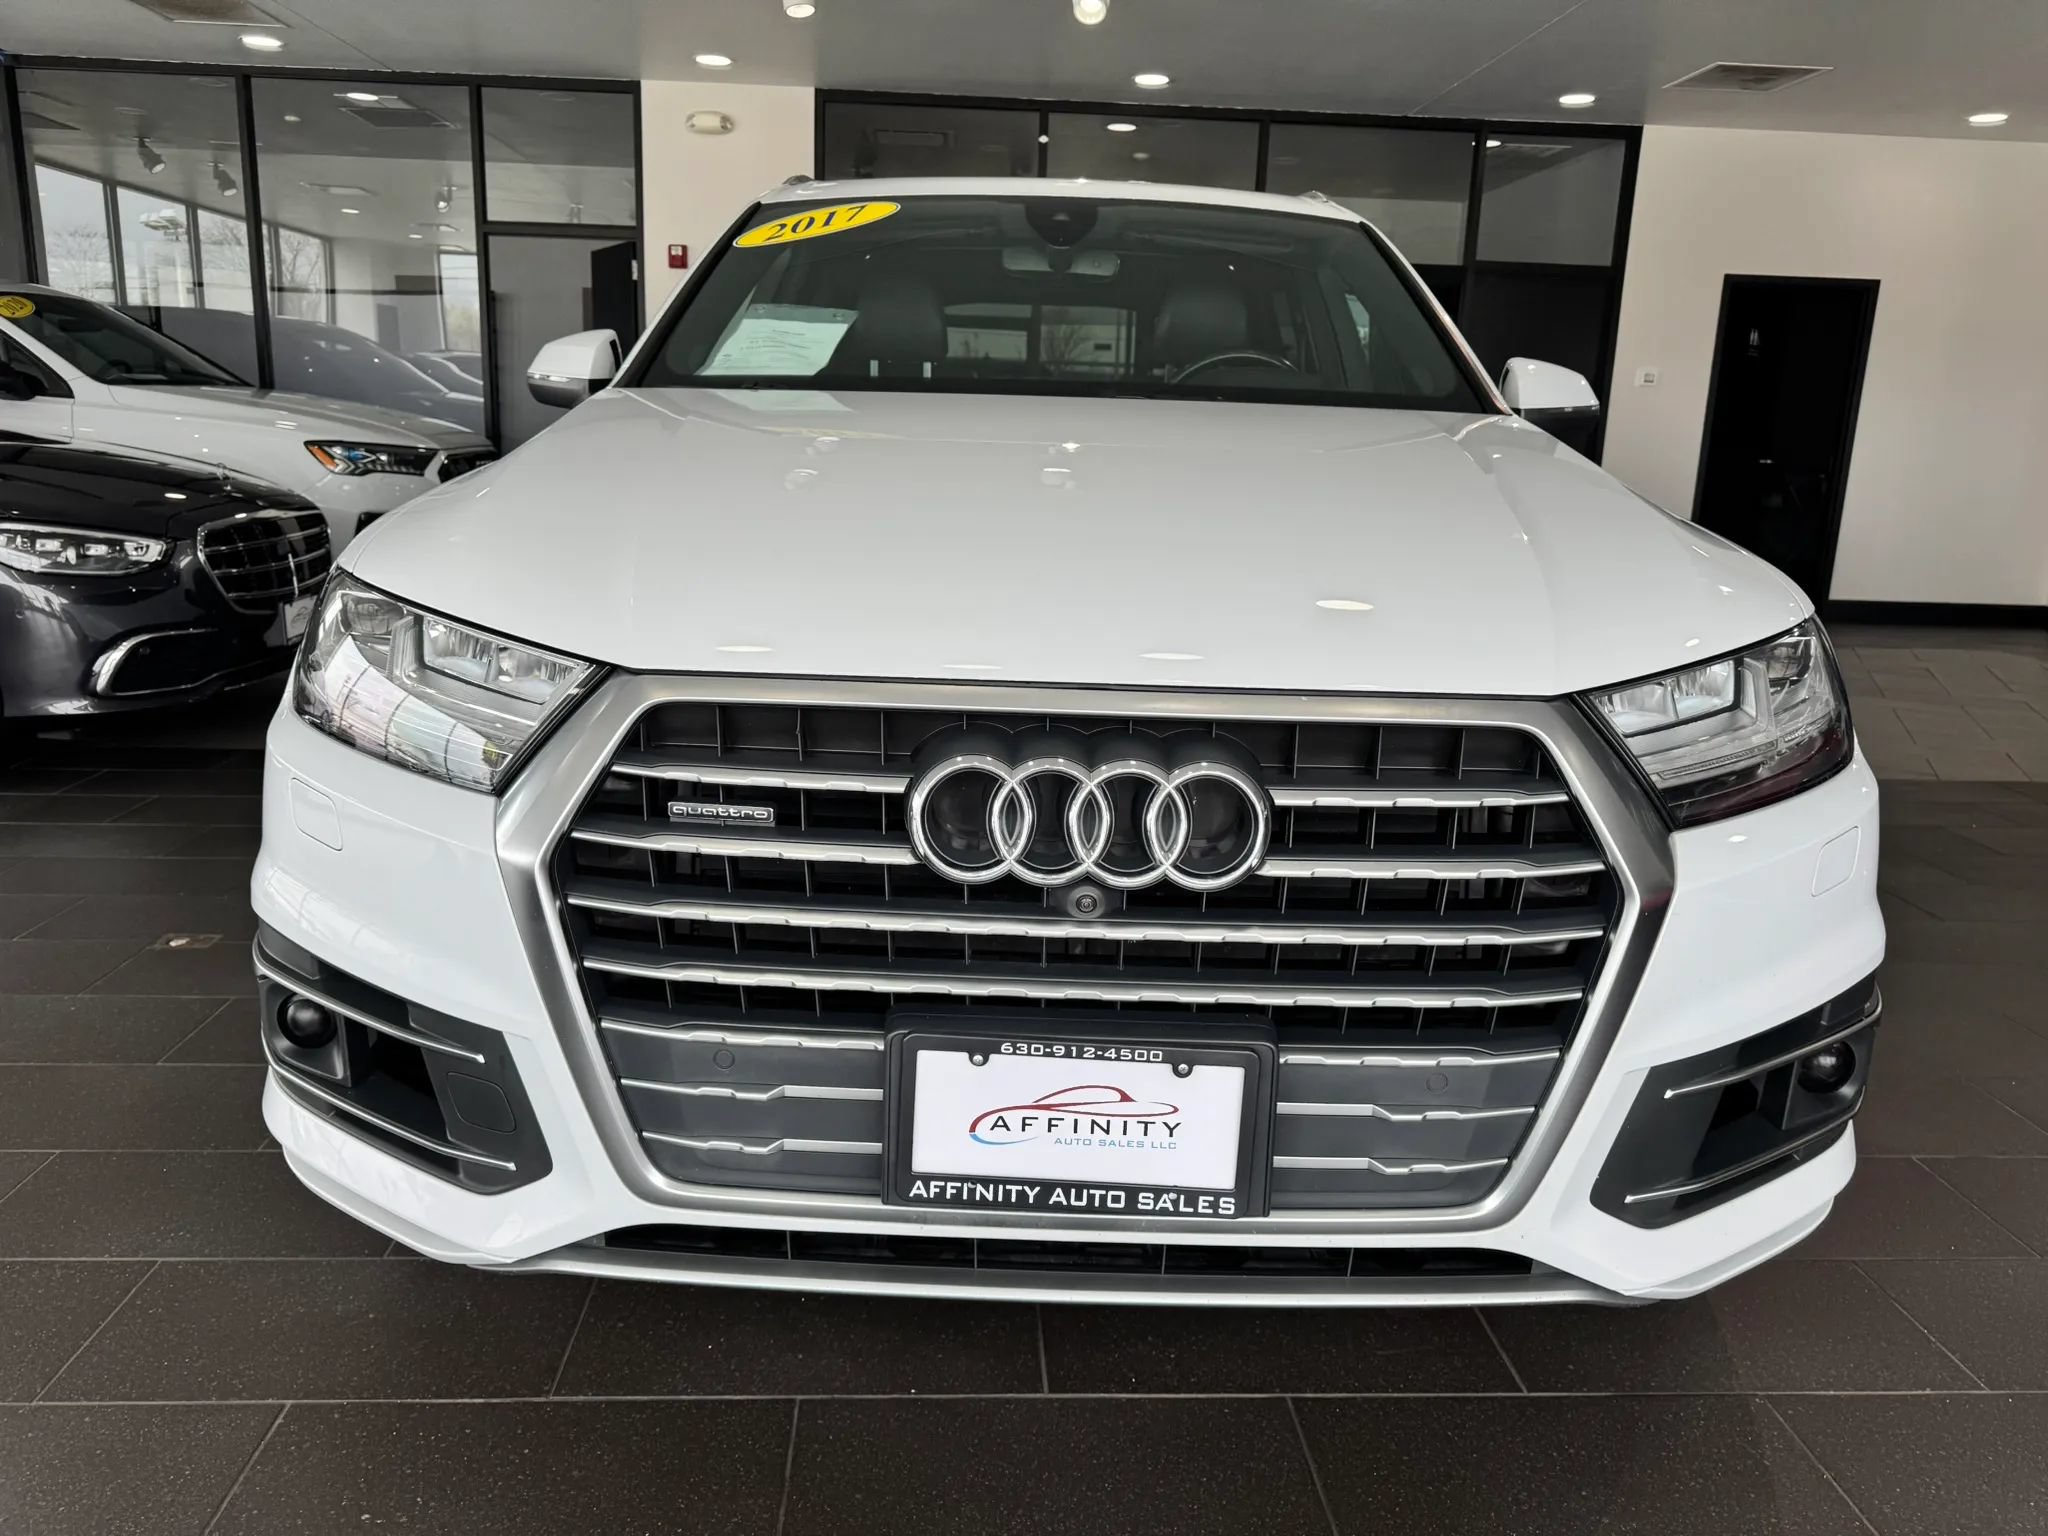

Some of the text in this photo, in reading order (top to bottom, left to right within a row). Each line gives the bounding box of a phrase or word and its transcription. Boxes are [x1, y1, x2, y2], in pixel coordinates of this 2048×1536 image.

[763, 203, 868, 242] 2017
[672, 805, 768, 818] quattro
[1000, 1042, 1163, 1062] 630-912-4500
[989, 1115, 1182, 1138] AFFINITY
[1053, 1137, 1177, 1150] AUTO SALES LLC
[909, 1180, 1236, 1215] AFFINITY AUTO SALES
